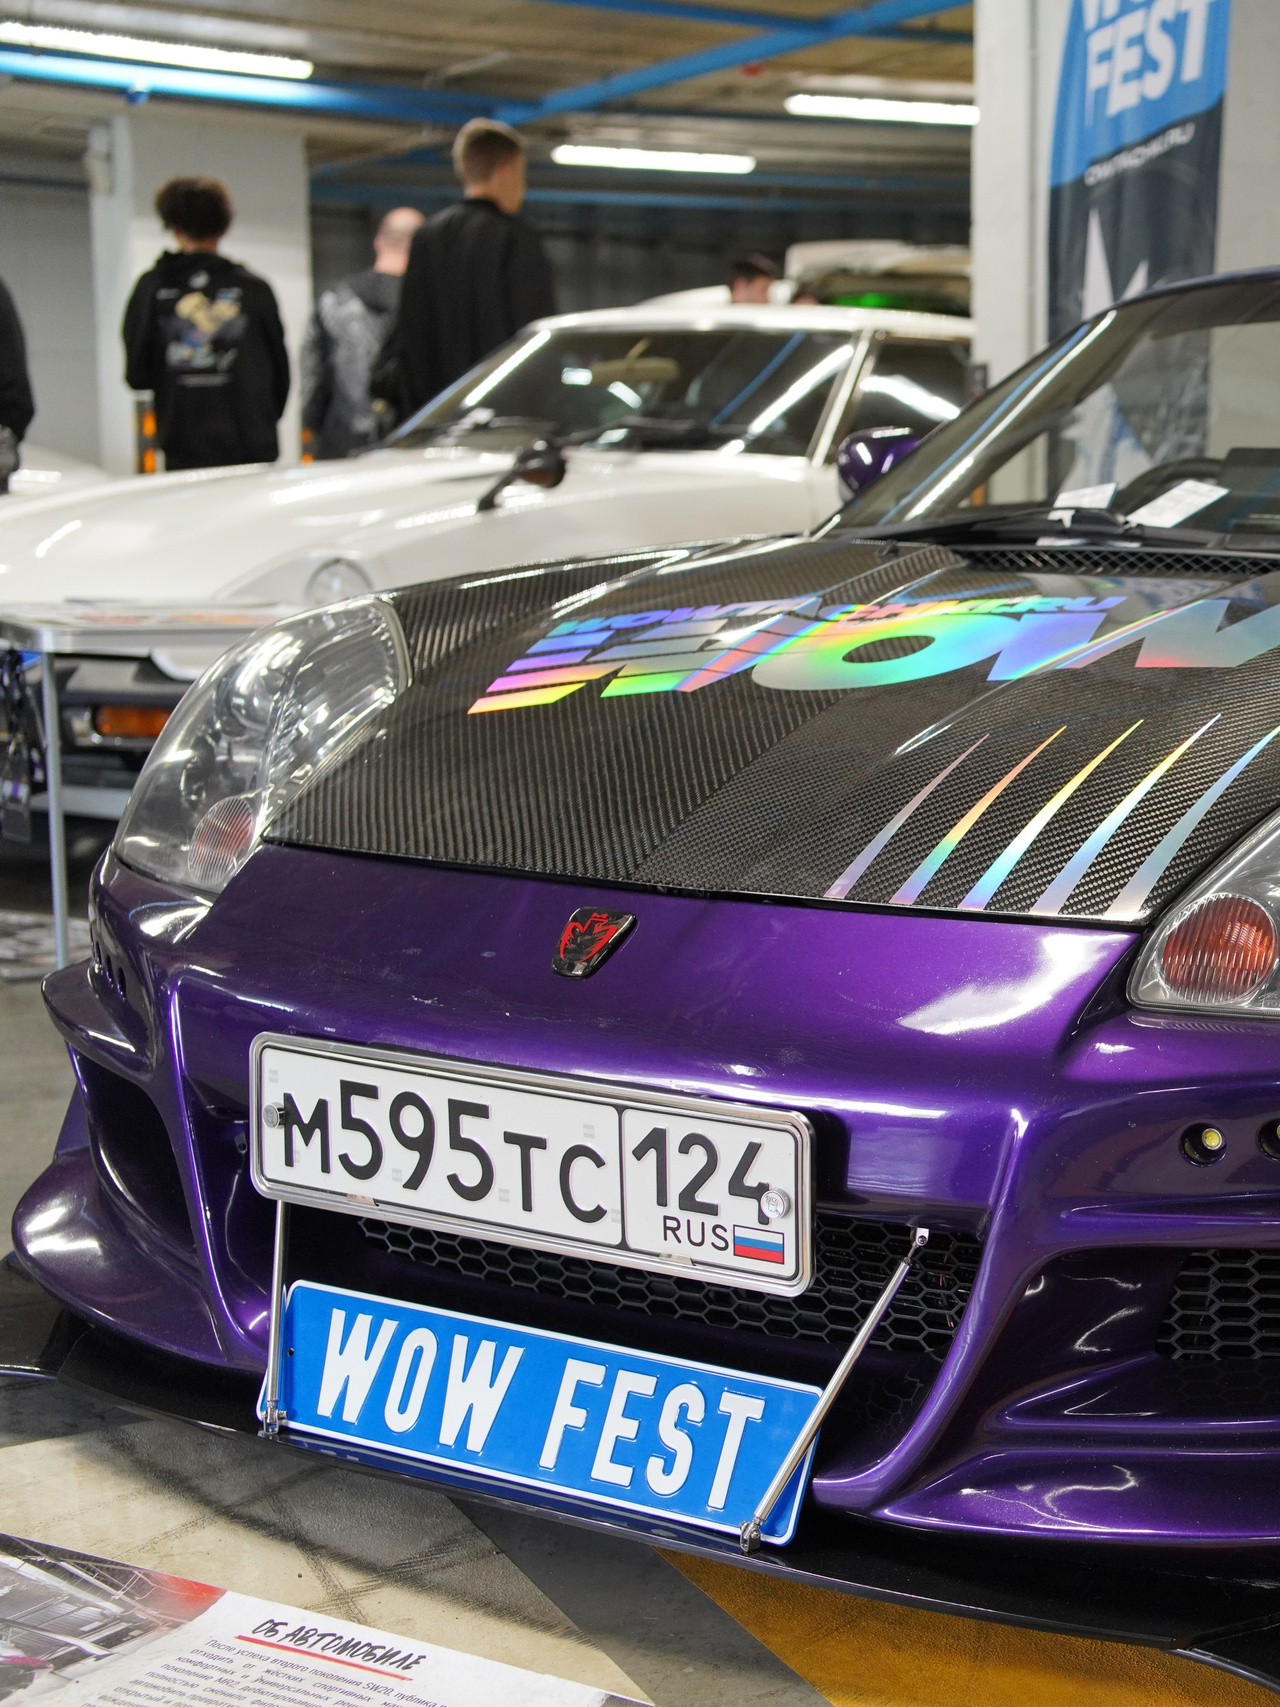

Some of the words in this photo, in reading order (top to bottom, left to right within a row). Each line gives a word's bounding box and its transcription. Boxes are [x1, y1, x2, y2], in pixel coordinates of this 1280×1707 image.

[1086, 0, 1209, 120] FEST
[631, 1126, 771, 1226] 124
[663, 1215, 730, 1252] RUS
[316, 1308, 525, 1453] WOW
[538, 1358, 767, 1511] FEST
[175, 1656, 238, 1676] комфортных
[205, 1639, 237, 1653] После
[233, 1648, 271, 1662] успеха
[270, 1658, 309, 1673] второго
[308, 1668, 363, 1687] поколения
[252, 1619, 288, 1638] ОБ
[277, 1625, 427, 1671] АВТОМОБИЛЕ
[129, 1679, 187, 1697] автомобиль
[145, 1671, 200, 1689] полностью
[159, 1663, 214, 1681] поколение
[190, 1648, 234, 1664] отходить
[312, 1682, 374, 1703] спортивных
[113, 1686, 166, 1702] открытый
